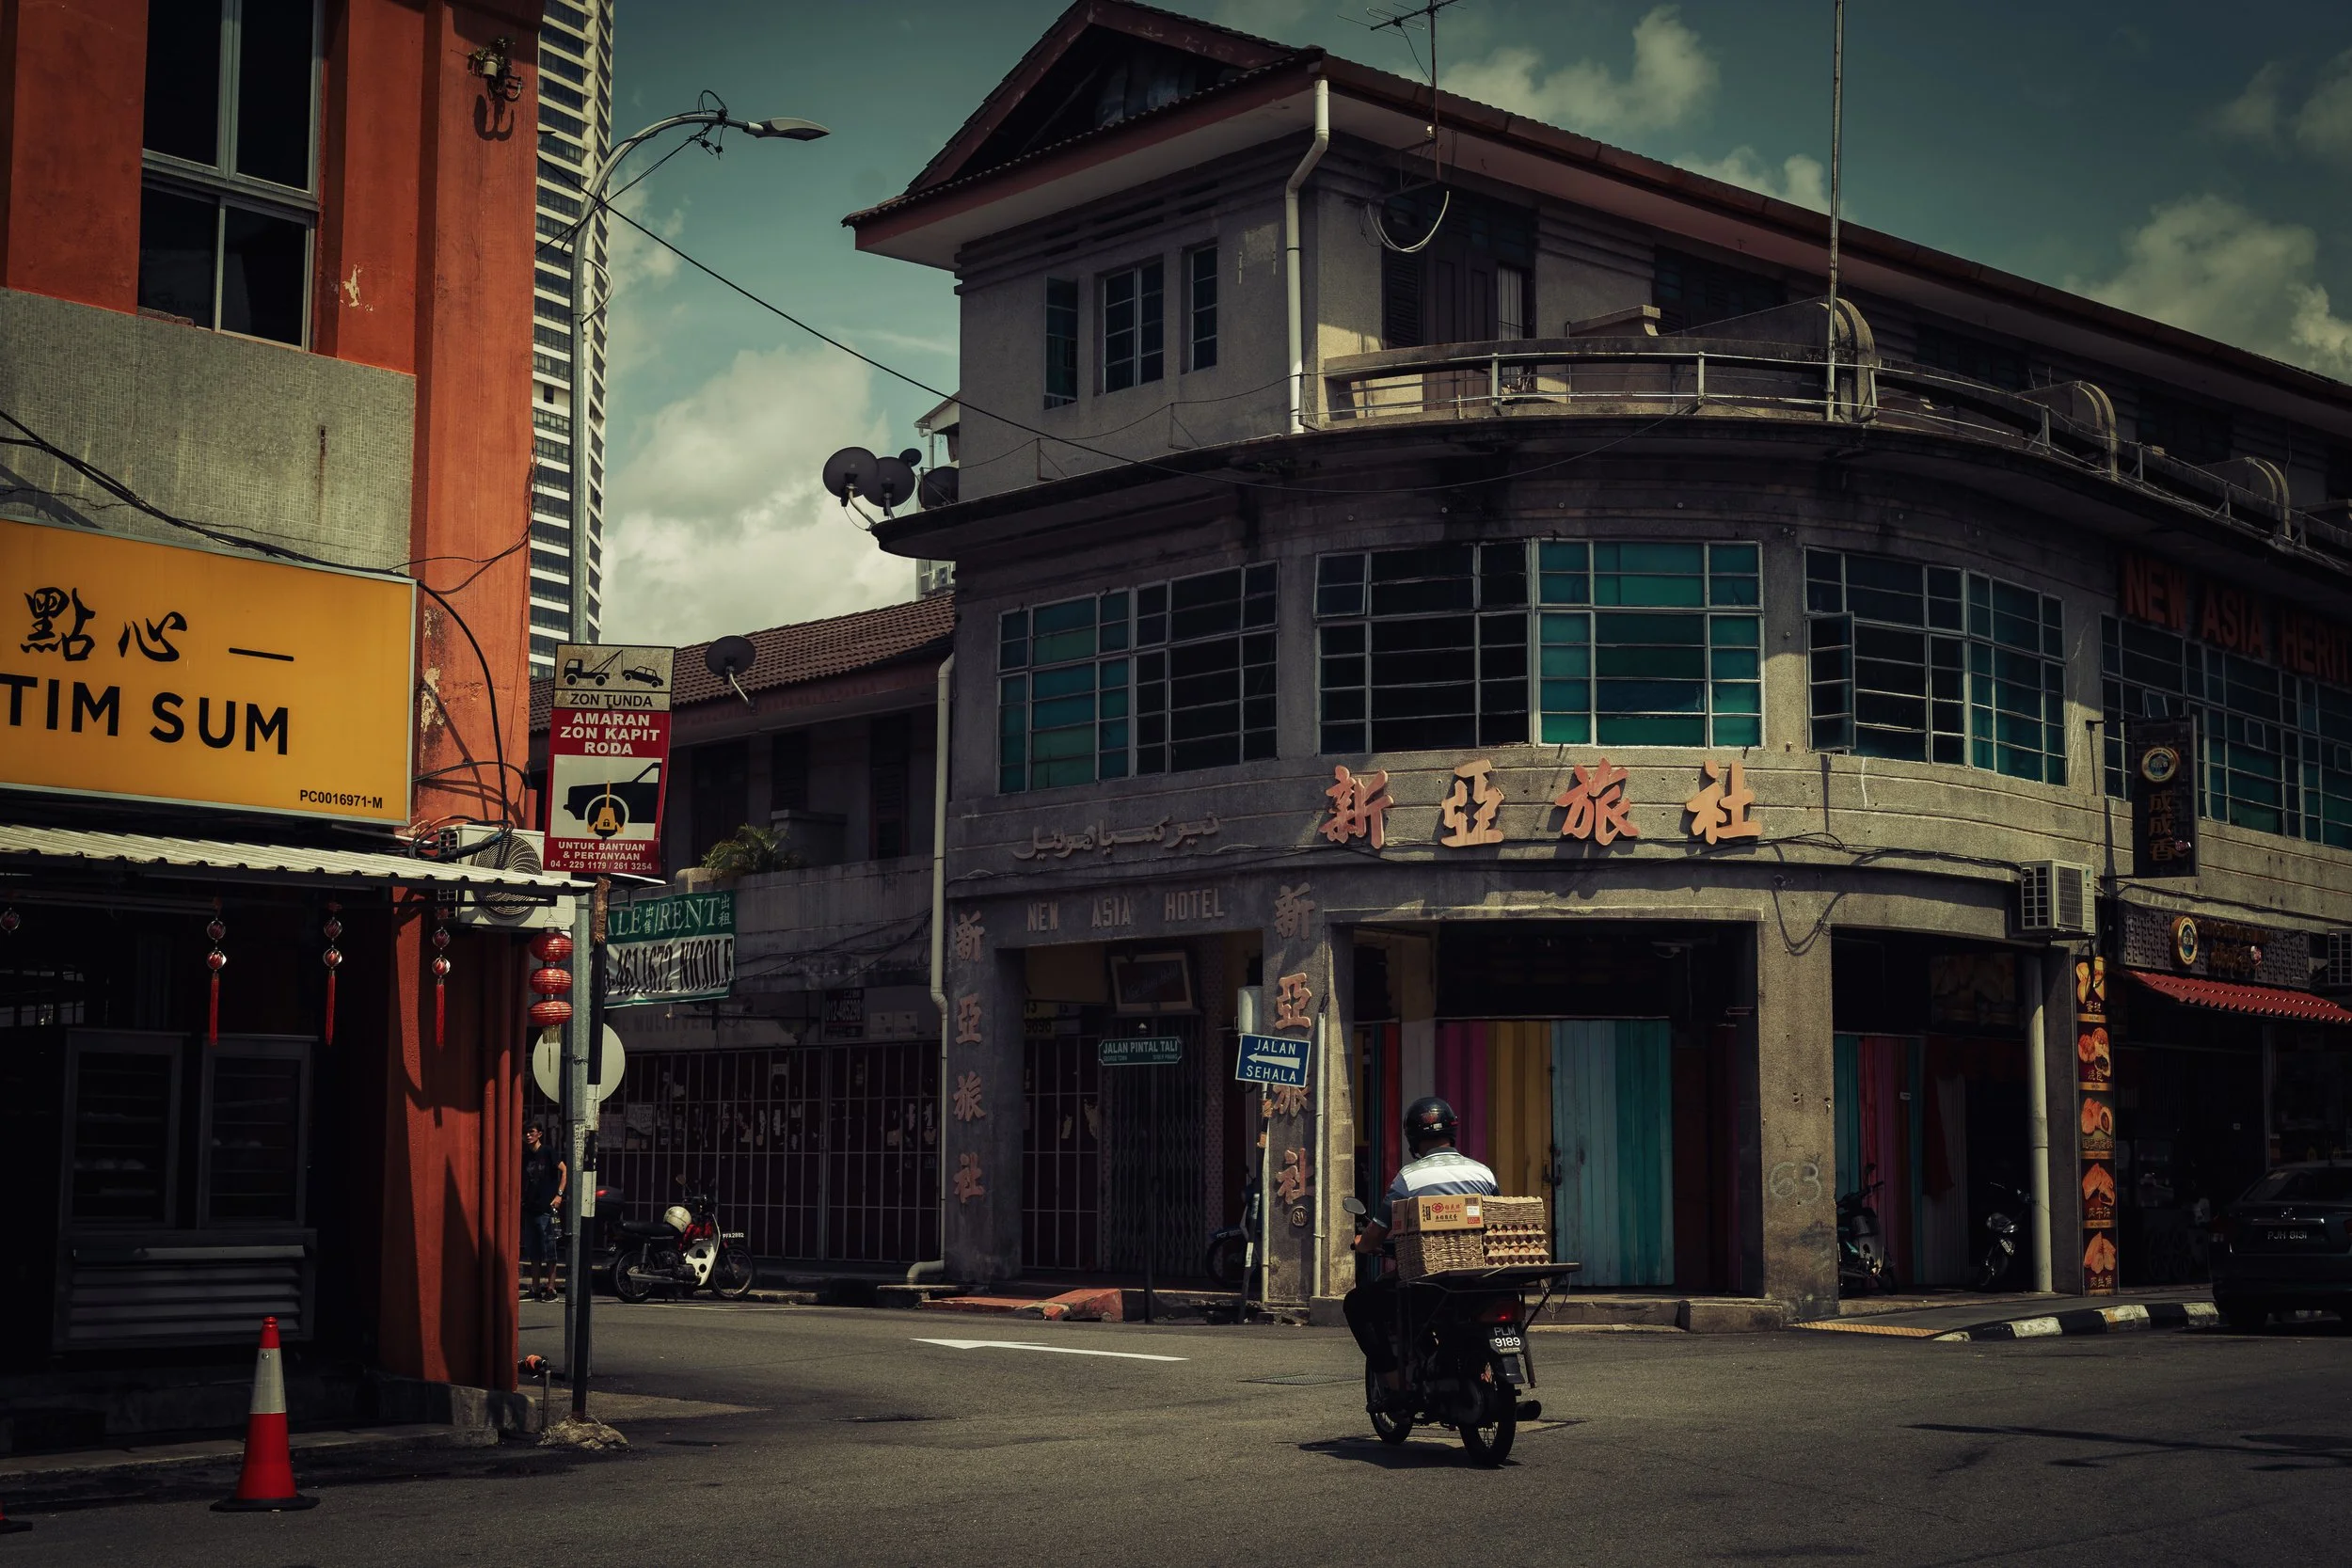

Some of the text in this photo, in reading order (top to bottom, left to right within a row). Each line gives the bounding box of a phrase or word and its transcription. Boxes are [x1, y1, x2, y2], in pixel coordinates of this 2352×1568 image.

[21, 586, 188, 662] 點心
[2122, 550, 2352, 686] NEW ASIA HERIT
[570, 693, 653, 707] ZON TUNDA
[0, 673, 289, 756] TIM SUM
[572, 712, 650, 727] AMARAN
[560, 726, 661, 742] ZON KAPIT
[583, 741, 634, 755] RODA
[299, 789, 383, 810] PC0016971-M
[1319, 756, 1765, 850] 新亞旅社
[558, 841, 646, 852] UNTUK BANTUAN
[574, 851, 641, 861] PERTANYAAN
[550, 860, 561, 868] 04
[569, 861, 587, 869] 229
[588, 861, 607, 869] 1179
[614, 861, 629, 870] 261
[631, 862, 653, 871] 3254
[1026, 887, 1225, 932] NEW ASIA HOTEL
[679, 938, 734, 991] NICOLE
[1104, 1039, 1178, 1054] JALAN PINTAL TALI
[1254, 1038, 1296, 1055] JALAN
[953, 910, 987, 1205] 新亞旅社
[1247, 1065, 1296, 1083] SEHALA
[2267, 1230, 2308, 1240] PJH 8131
[1494, 1325, 1516, 1336] PLM
[1495, 1337, 1521, 1347] 9189
